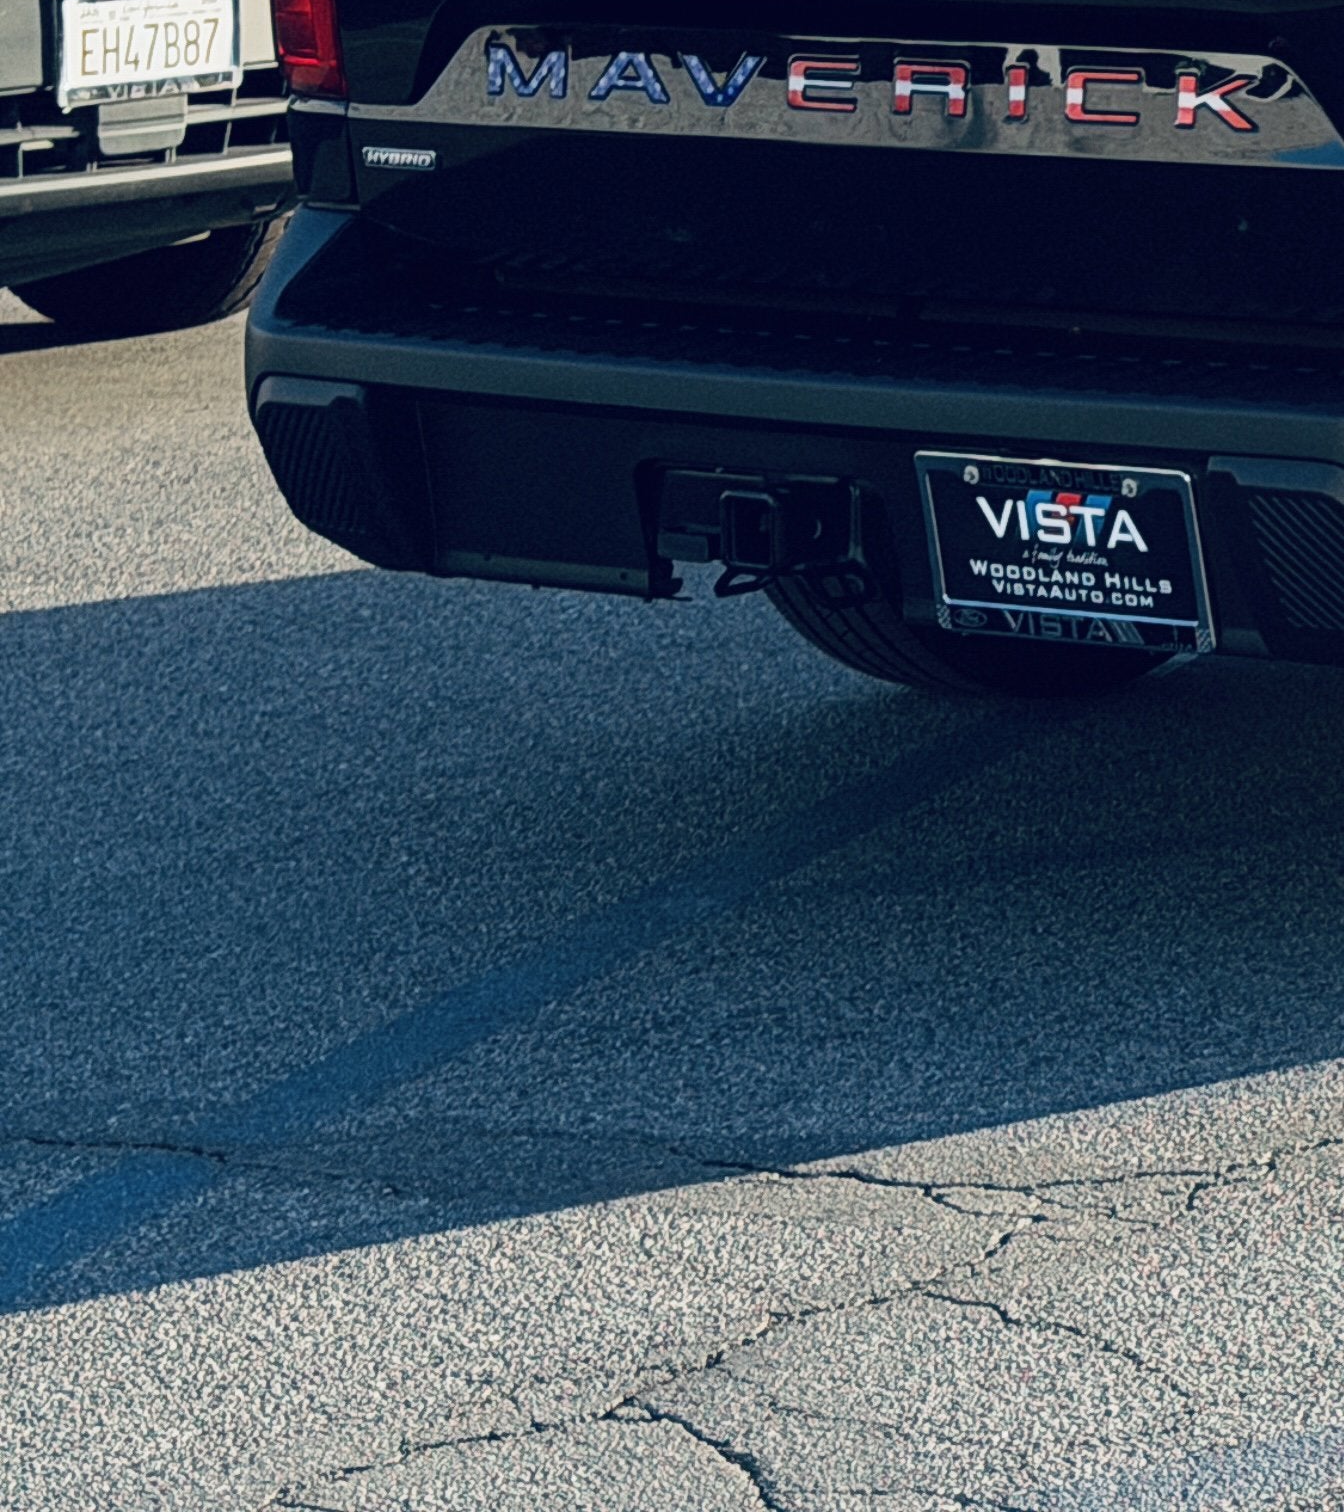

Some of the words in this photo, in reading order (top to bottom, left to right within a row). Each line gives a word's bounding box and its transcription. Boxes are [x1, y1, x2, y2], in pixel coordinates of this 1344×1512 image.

[80, 17, 220, 77] EH47B87
[485, 41, 1260, 134] MAVERICK
[366, 150, 432, 167] HYBRID
[975, 496, 1149, 553] VISTA
[969, 558, 1096, 587] WOODLAND
[1002, 609, 1114, 643] VISTA
